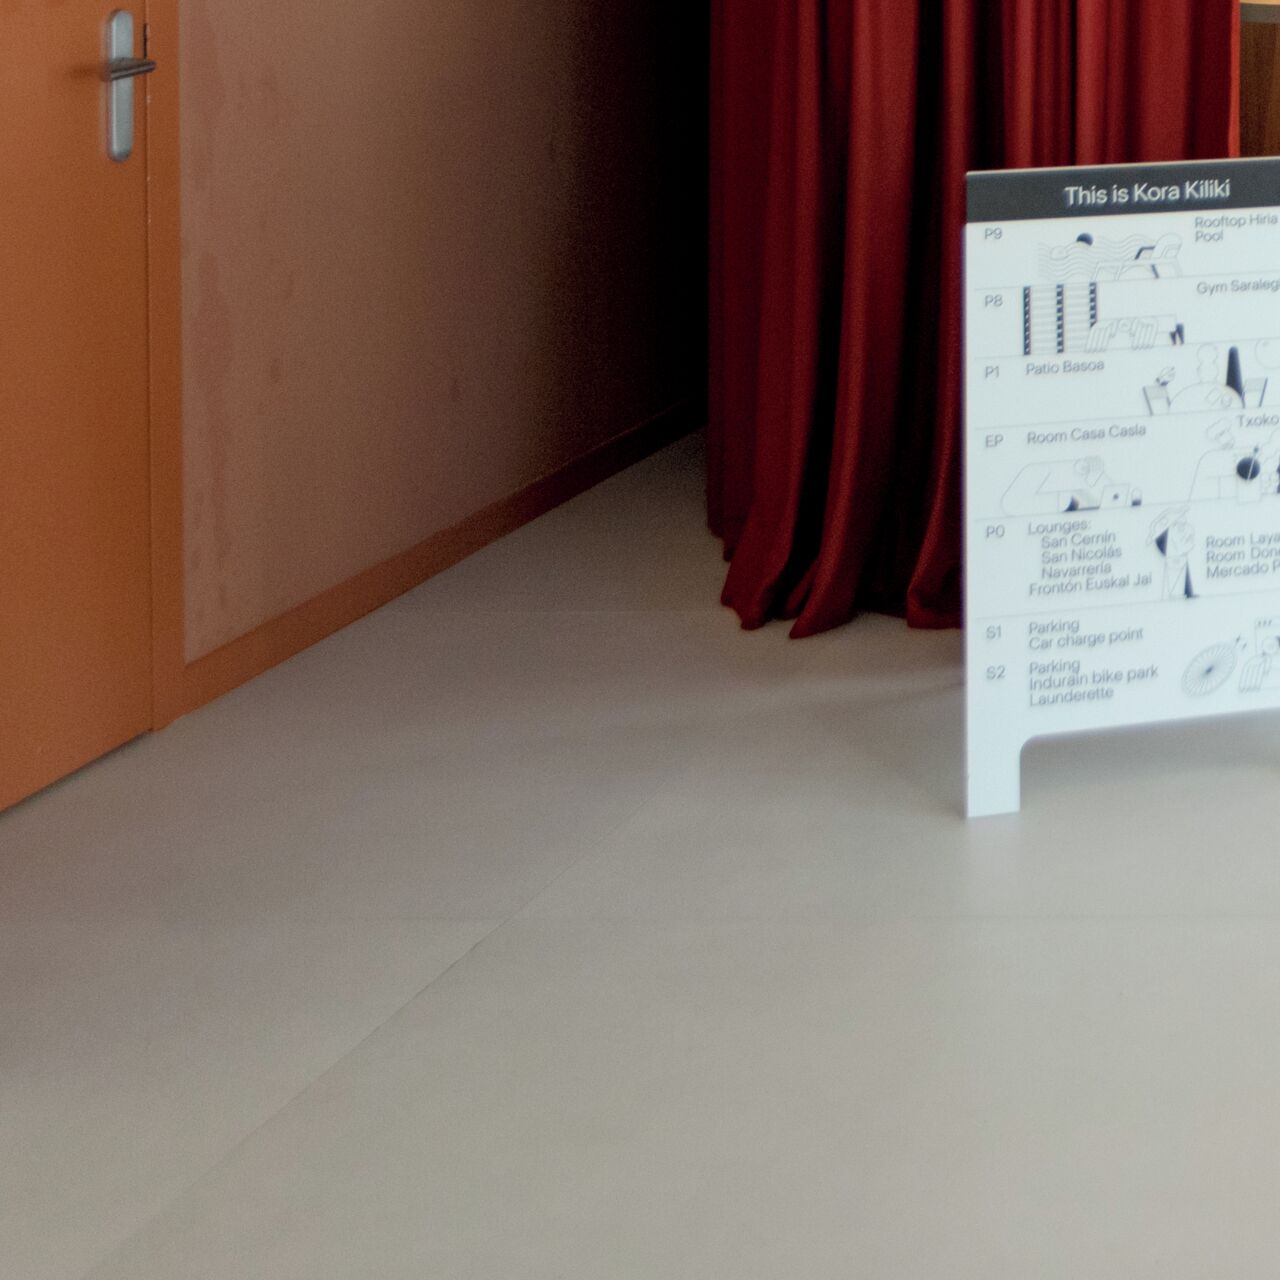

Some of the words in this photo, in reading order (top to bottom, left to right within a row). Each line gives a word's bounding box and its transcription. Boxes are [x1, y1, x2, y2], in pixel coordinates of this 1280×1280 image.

[1065, 185, 1107, 207] This
[1112, 184, 1129, 204] is
[1134, 182, 1180, 203] Kora
[1185, 179, 1231, 200] Kiliki
[1194, 215, 1247, 229] Rooftop
[984, 227, 1003, 240] P9
[1194, 229, 1224, 242] Pool
[1196, 281, 1228, 296] Gym
[984, 294, 1004, 308] P8
[985, 365, 1000, 379] P1
[1025, 362, 1060, 376] Patio
[1063, 359, 1105, 374] Basoa
[1236, 413, 1280, 428] Txoko
[985, 434, 1005, 449] EP
[1027, 430, 1068, 445] Room
[1071, 428, 1106, 441] Casa
[1027, 520, 1092, 536] Lounges:
[1041, 535, 1067, 550] San
[1206, 534, 1246, 548] Room
[1041, 550, 1068, 565] San
[1071, 545, 1123, 562] Nicolás
[1206, 550, 1246, 564] Room
[1041, 561, 1113, 579] Navarrería
[1206, 561, 1270, 579] Mercado
[1028, 579, 1082, 597] Frontón
[1085, 575, 1130, 592] Euskal
[1133, 571, 1153, 587] Jai
[985, 624, 1003, 640] S1
[1028, 619, 1081, 635] Parking
[1028, 636, 1054, 651] Car
[1057, 632, 1105, 648] charge
[1109, 627, 1144, 645] point
[985, 664, 1006, 681] S2
[1029, 659, 1081, 675] Parking
[1092, 668, 1124, 685] bike
[1127, 663, 1159, 685] park
[1030, 687, 1114, 707] Launderette
